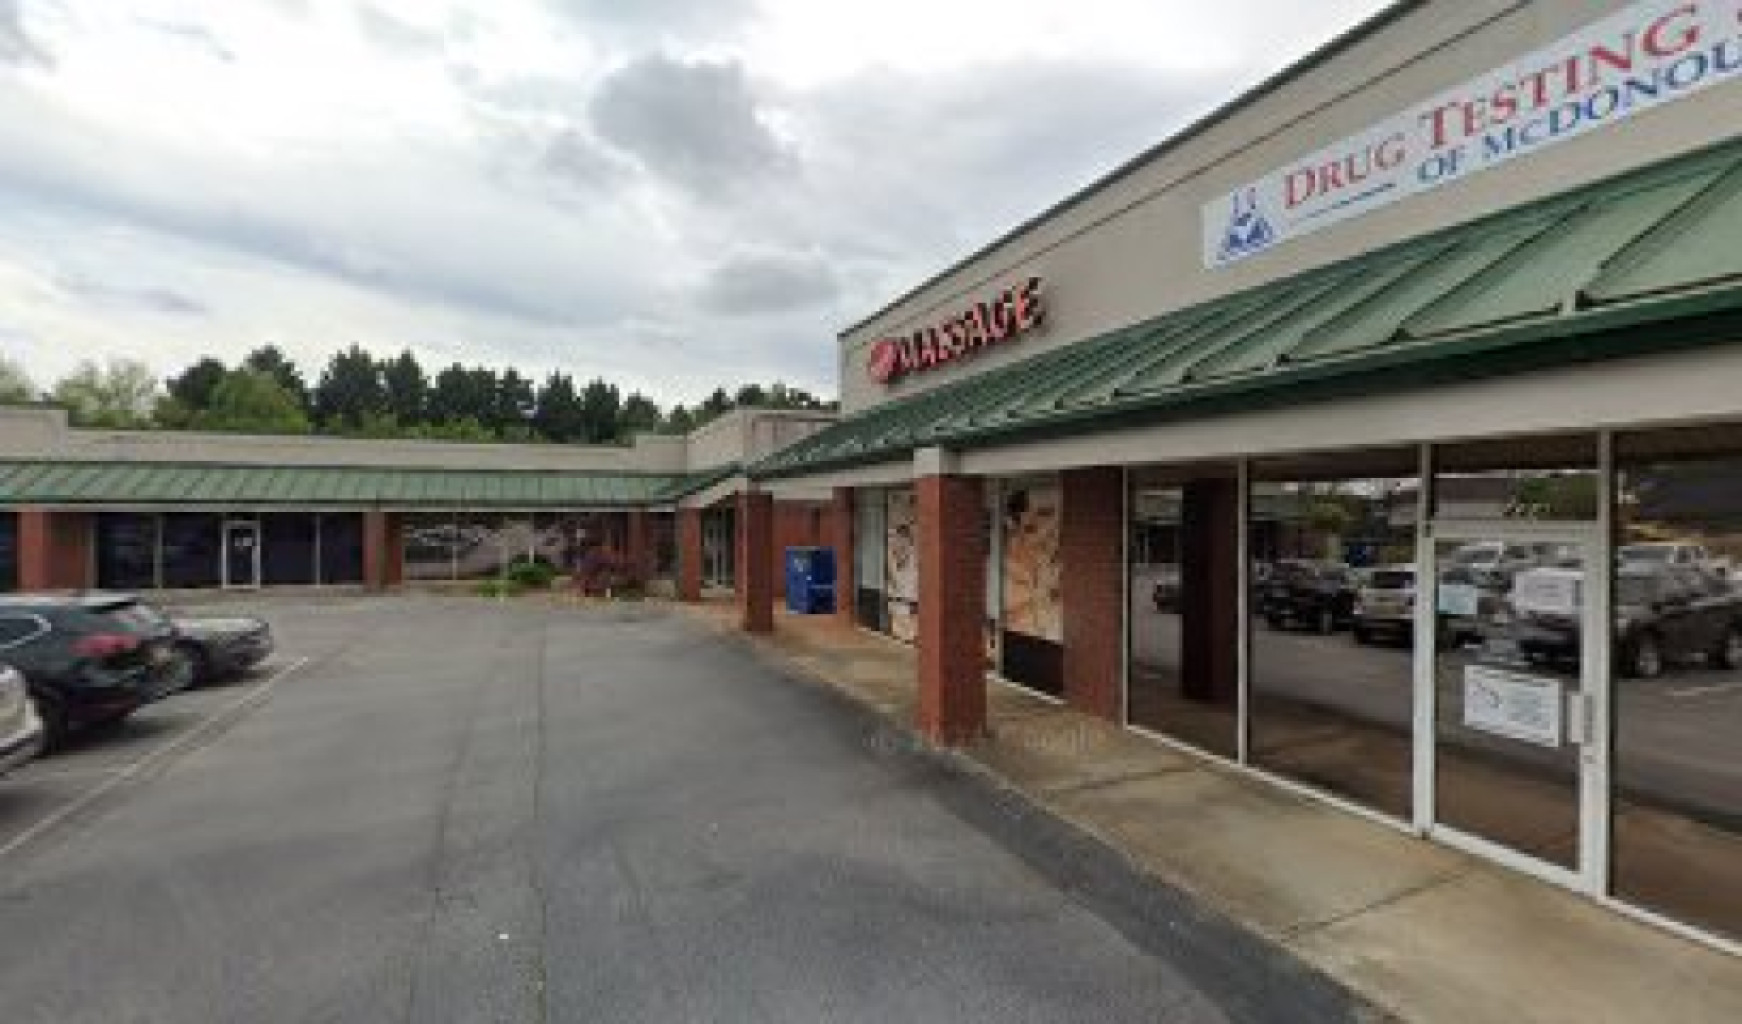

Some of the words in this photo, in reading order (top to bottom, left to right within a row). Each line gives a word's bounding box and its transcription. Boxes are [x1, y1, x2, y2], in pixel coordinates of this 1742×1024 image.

[1284, 131, 1407, 210] DRUG
[1416, 3, 1702, 150] TESTING
[1417, 149, 1466, 183] OF
[896, 277, 1048, 373] MASSAGE
